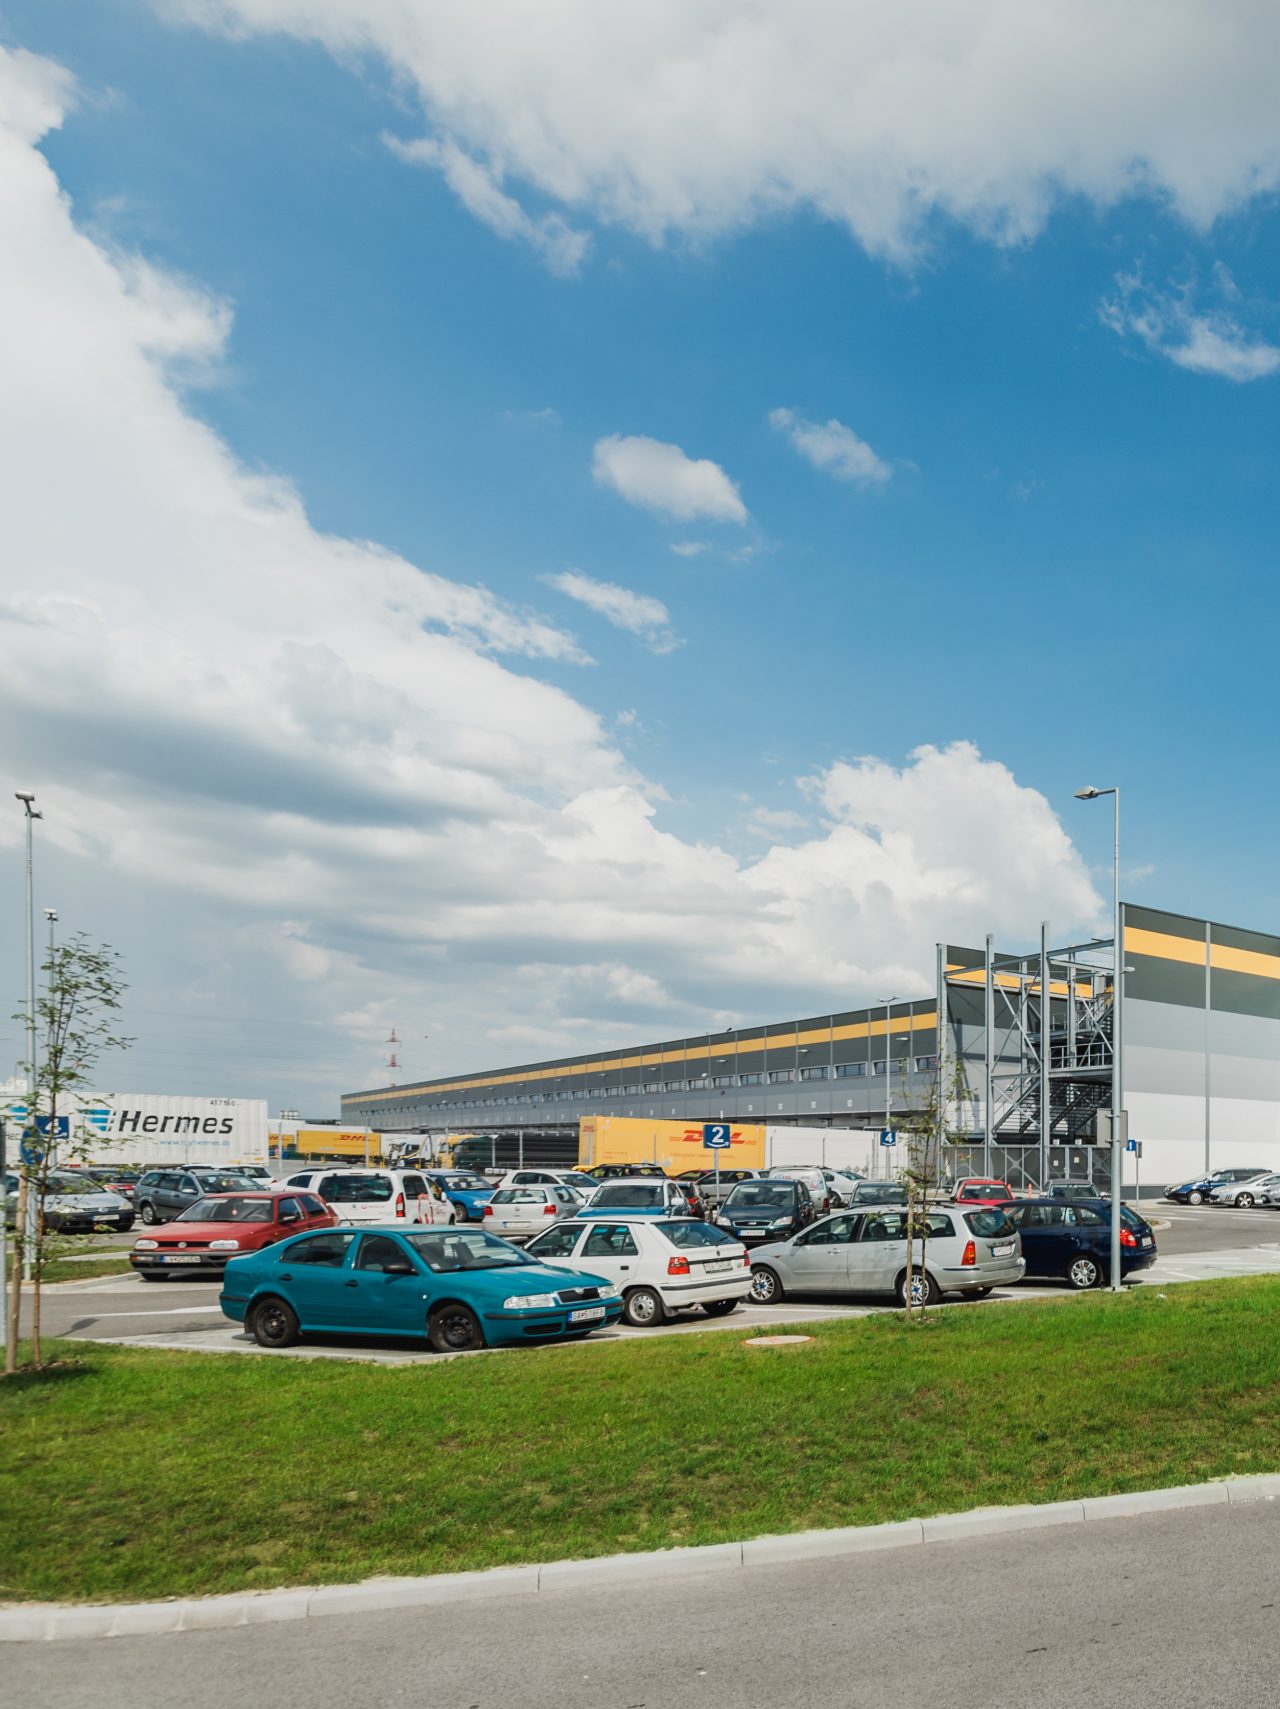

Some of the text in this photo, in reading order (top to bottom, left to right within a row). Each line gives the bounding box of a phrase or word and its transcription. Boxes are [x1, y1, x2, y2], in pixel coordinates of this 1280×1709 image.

[45, 1118, 62, 1134] 4
[118, 1111, 234, 1134] Hermes
[682, 1129, 745, 1145] DL
[712, 1126, 724, 1144] 2
[885, 1132, 893, 1143] 4
